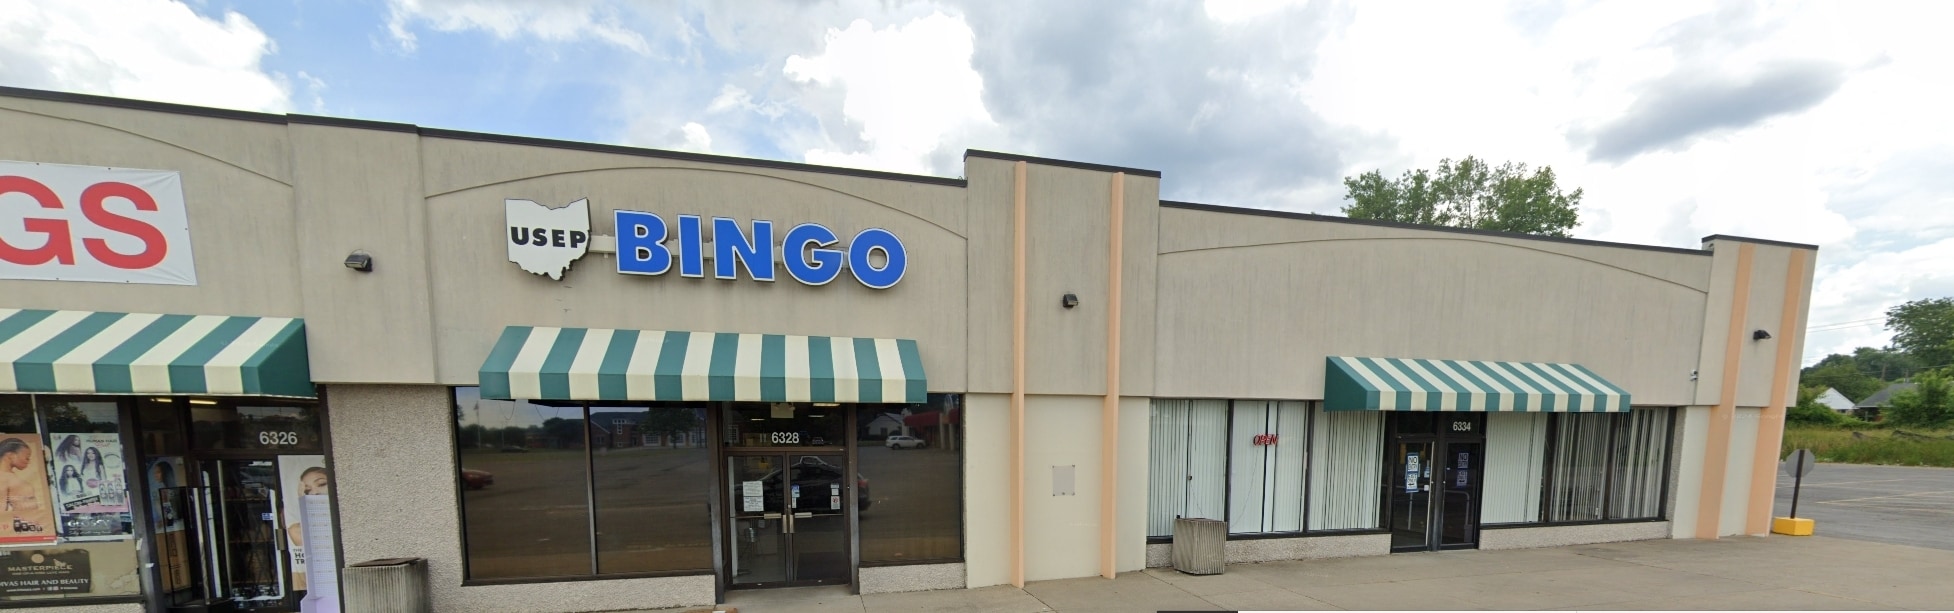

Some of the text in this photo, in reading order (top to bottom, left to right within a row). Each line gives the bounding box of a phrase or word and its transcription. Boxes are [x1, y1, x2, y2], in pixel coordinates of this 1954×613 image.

[510, 226, 587, 249] USEP
[613, 208, 908, 289] BINGO
[1453, 422, 1471, 431] 6334
[259, 431, 298, 445] 6326
[771, 432, 800, 443] 6328
[1253, 434, 1278, 446] OPEN
